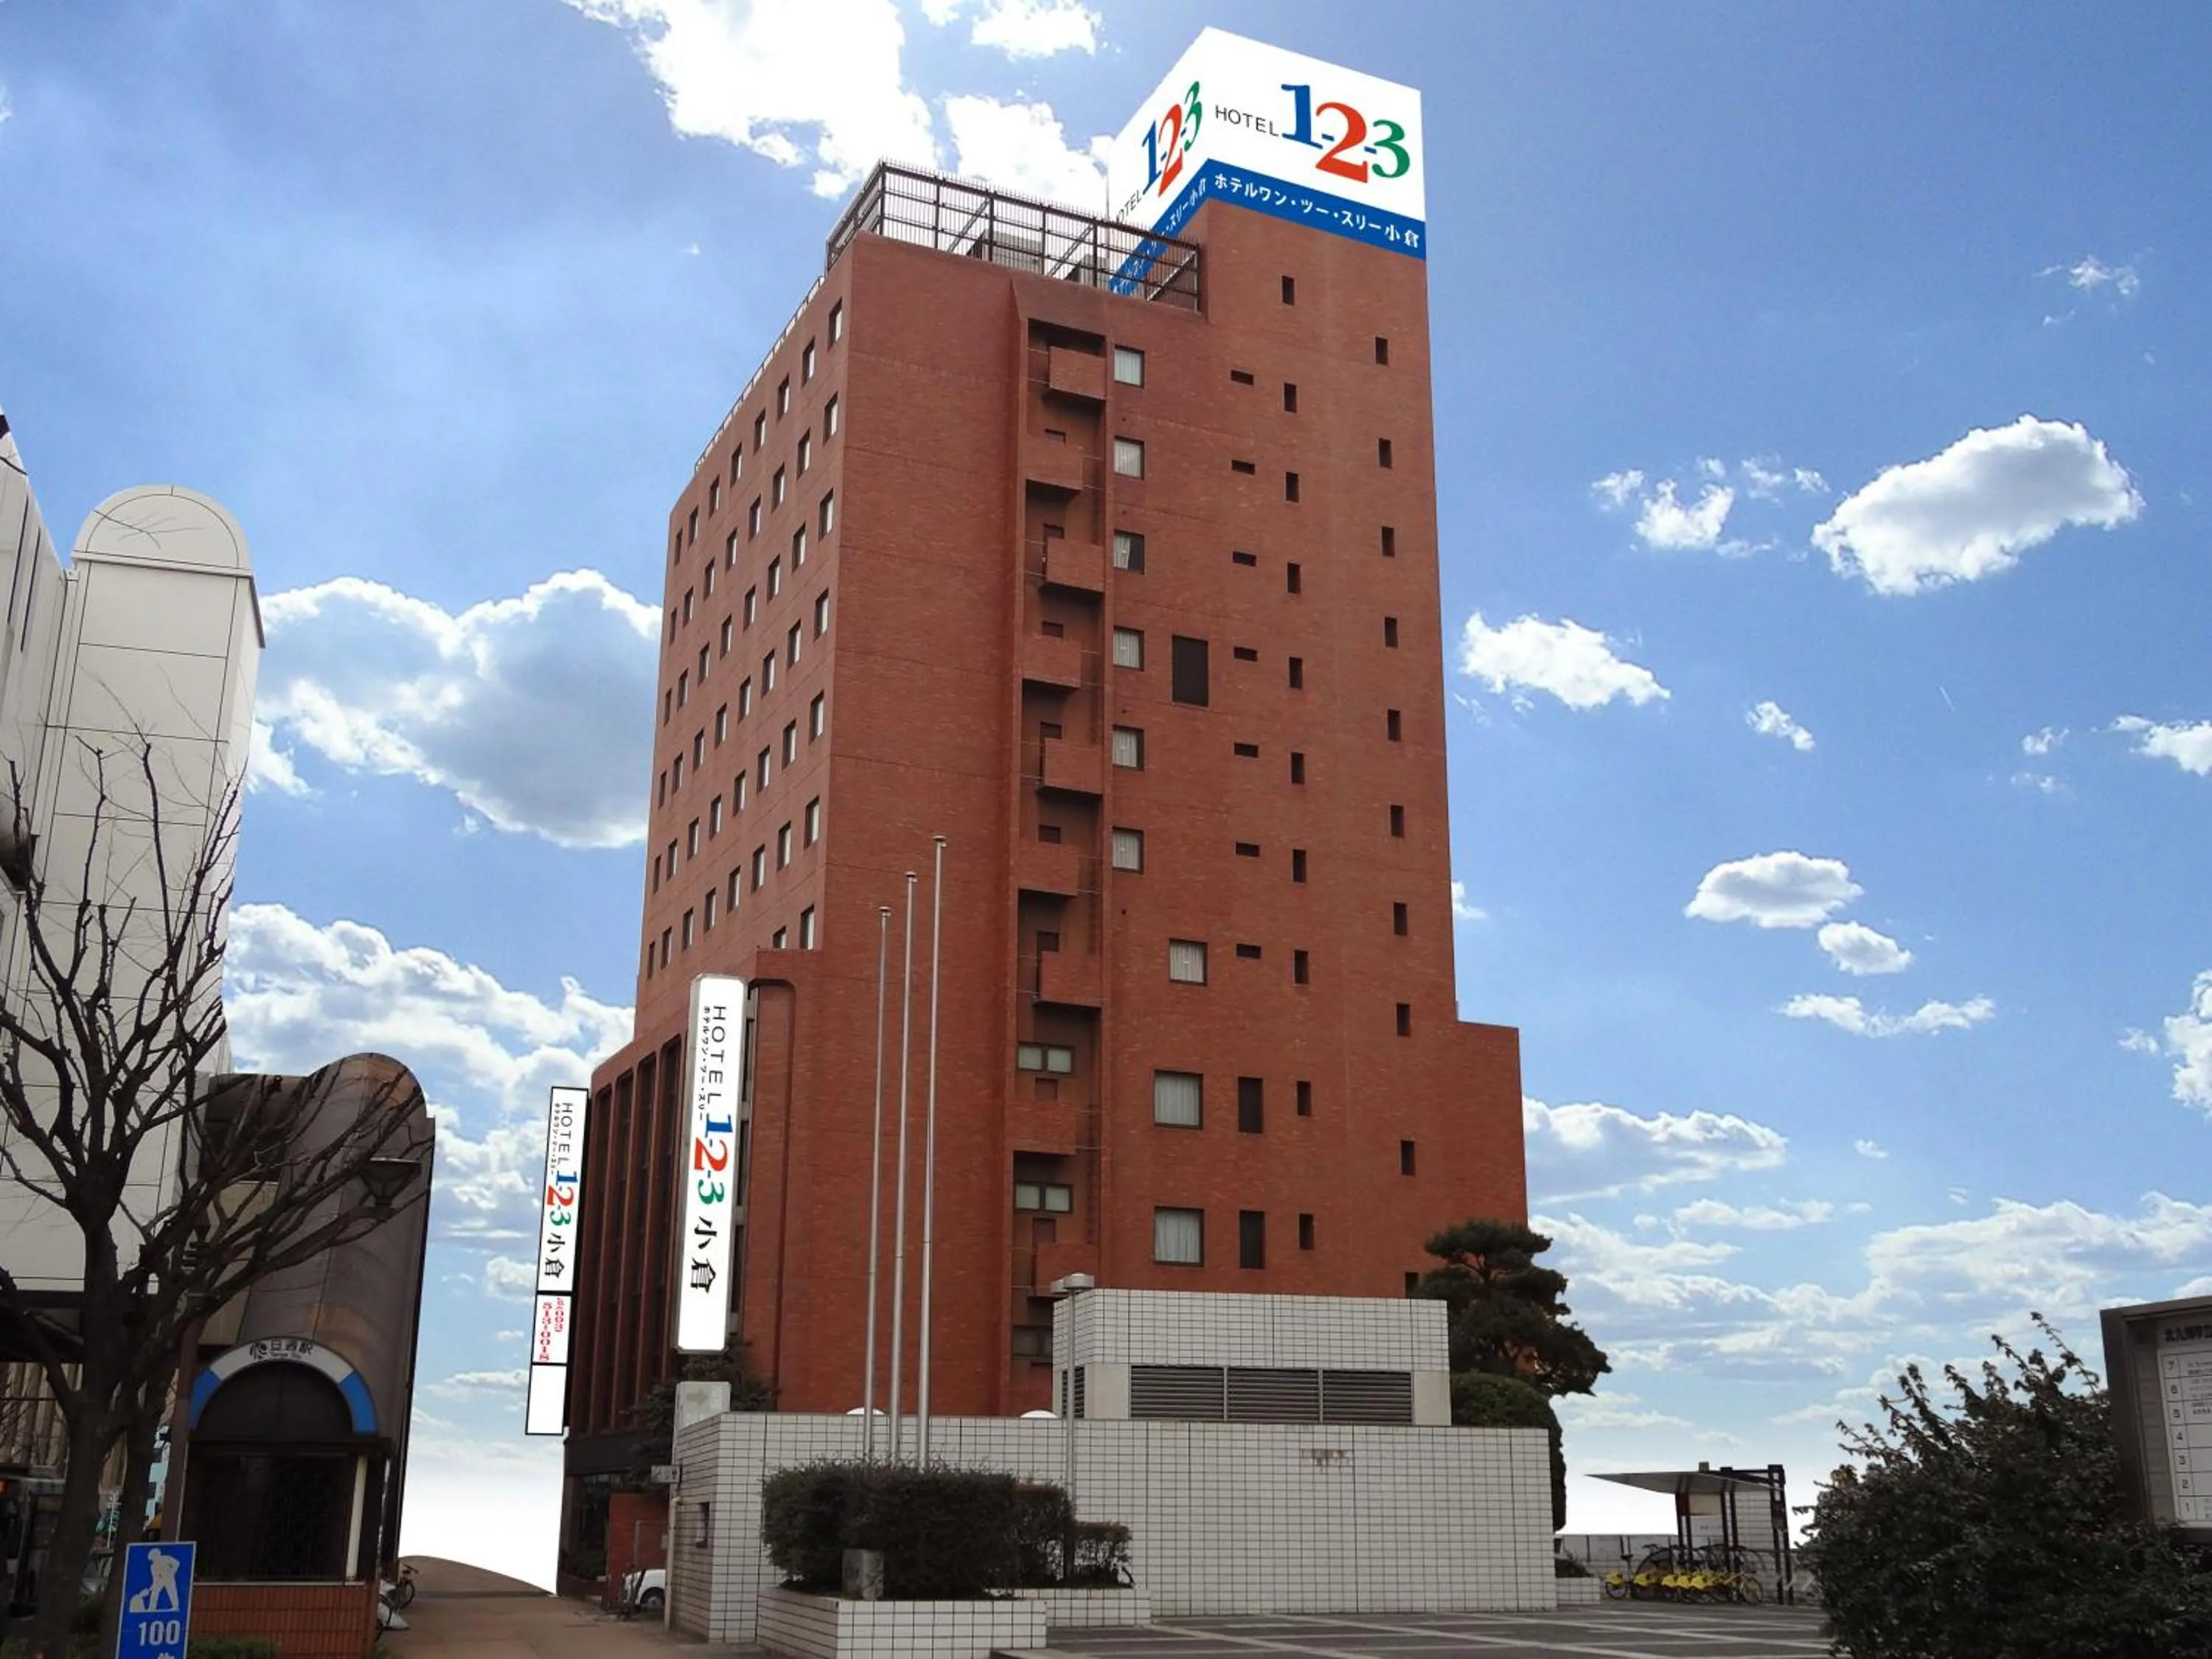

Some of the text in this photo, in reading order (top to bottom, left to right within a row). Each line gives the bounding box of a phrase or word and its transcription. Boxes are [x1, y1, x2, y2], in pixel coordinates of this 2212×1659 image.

[1141, 80, 1203, 198] 1-2-3
[1215, 84, 1410, 184] HOTEL 1-2-3
[1214, 173, 1419, 248] ホテルワン・ツー・スリー小倉
[557, 1102, 574, 1165] HOTEL
[691, 1005, 733, 1294] HOTEL 1-2-3 小倉
[546, 1171, 578, 1226] 1-2-3
[544, 1232, 566, 1279] 小倉
[139, 1620, 181, 1646] 100
